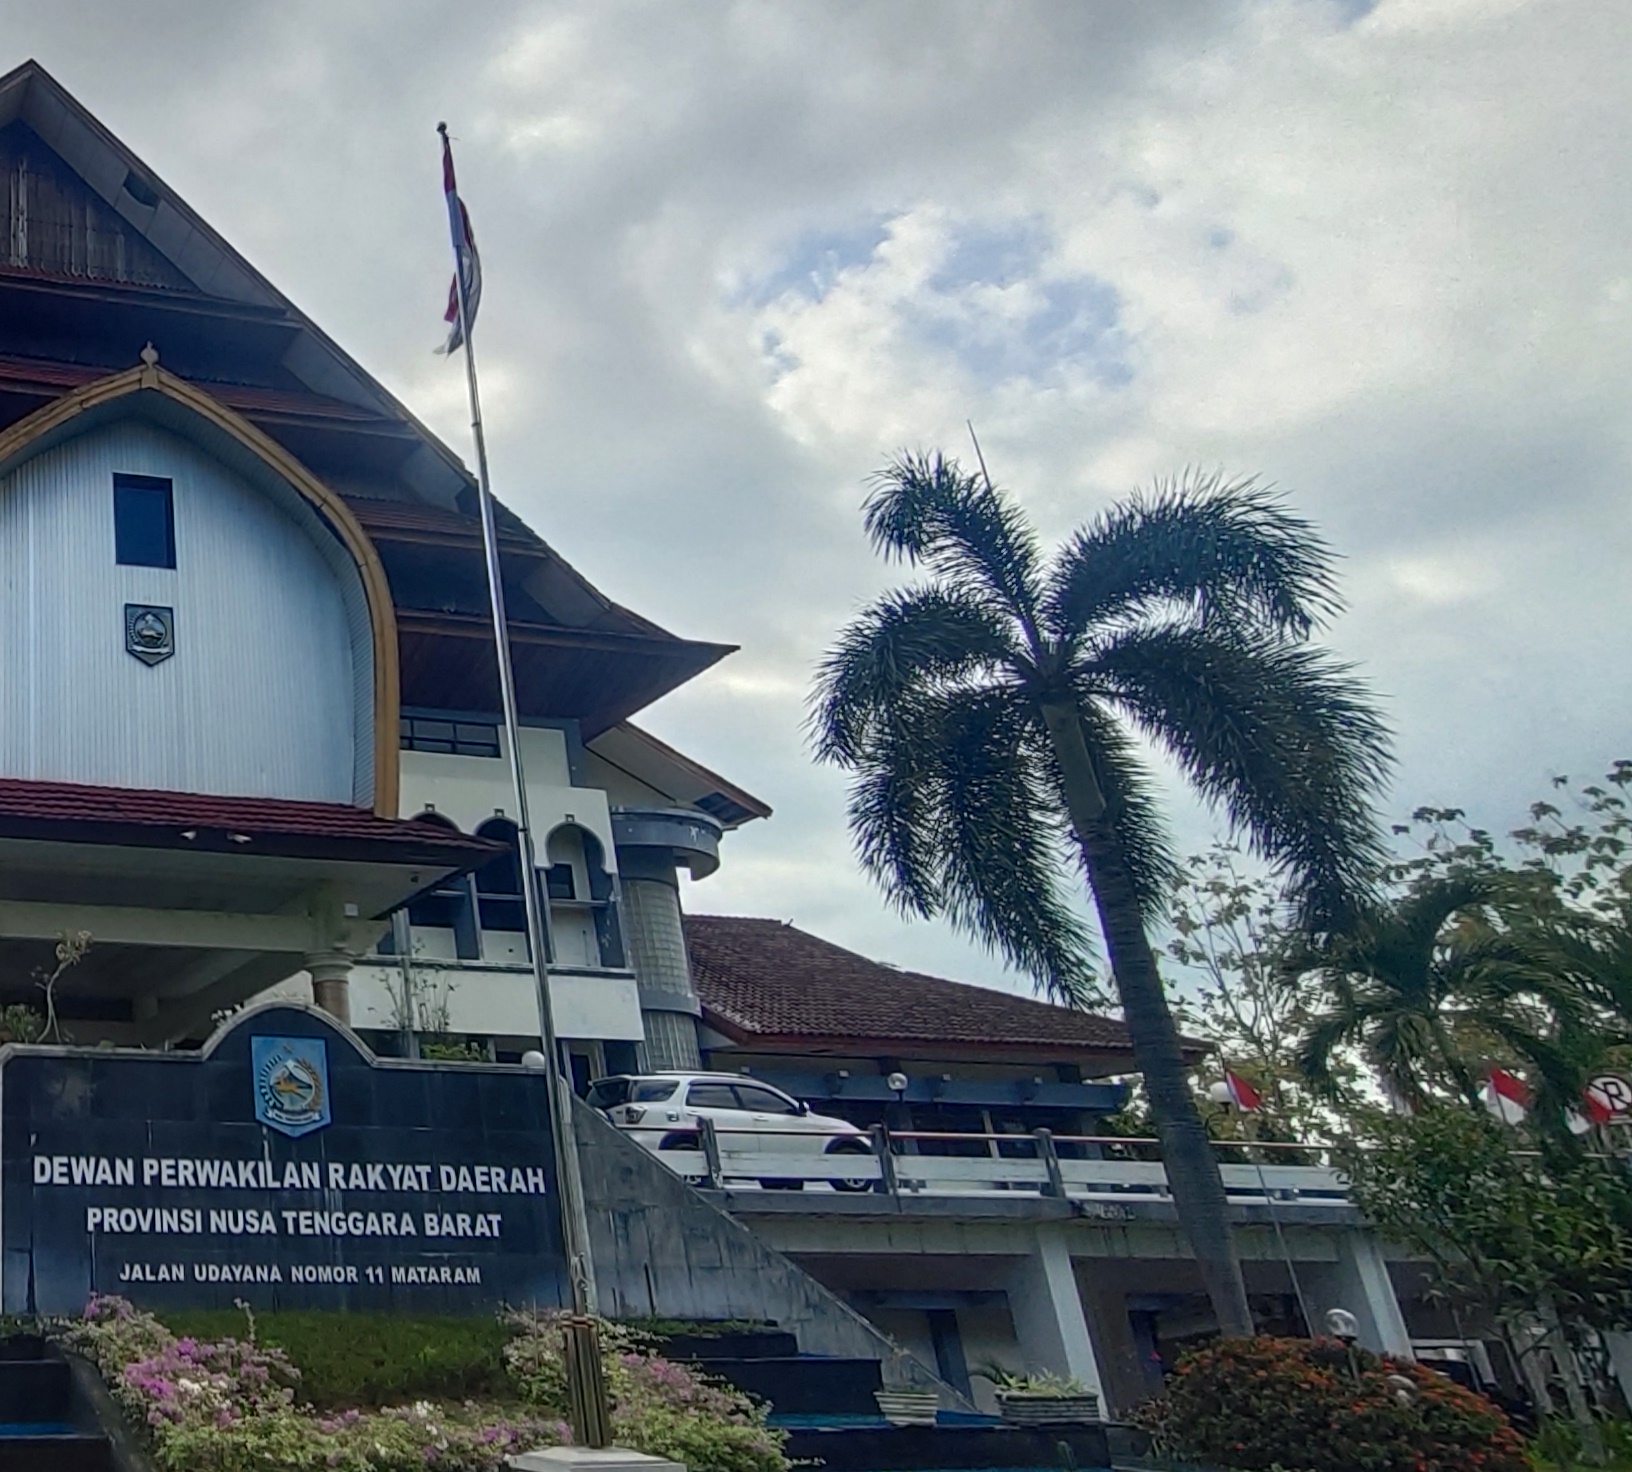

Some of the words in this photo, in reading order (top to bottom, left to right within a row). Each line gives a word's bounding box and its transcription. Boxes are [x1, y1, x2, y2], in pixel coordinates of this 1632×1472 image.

[33, 1155, 135, 1184] DEWAN
[143, 1158, 322, 1188] PERWAKILAN
[328, 1162, 433, 1190] RAKYAT
[439, 1165, 546, 1193] DAERAH
[86, 1207, 203, 1233] PROVINSI
[209, 1208, 277, 1233] NUSA
[282, 1210, 416, 1235] TENGGARA
[424, 1211, 503, 1236] BARAT
[119, 1263, 186, 1281] JALAN
[194, 1264, 283, 1282] UDAYANA
[291, 1265, 359, 1283] NOMOR
[365, 1266, 384, 1283] 11
[391, 1265, 482, 1283] MATARAM
